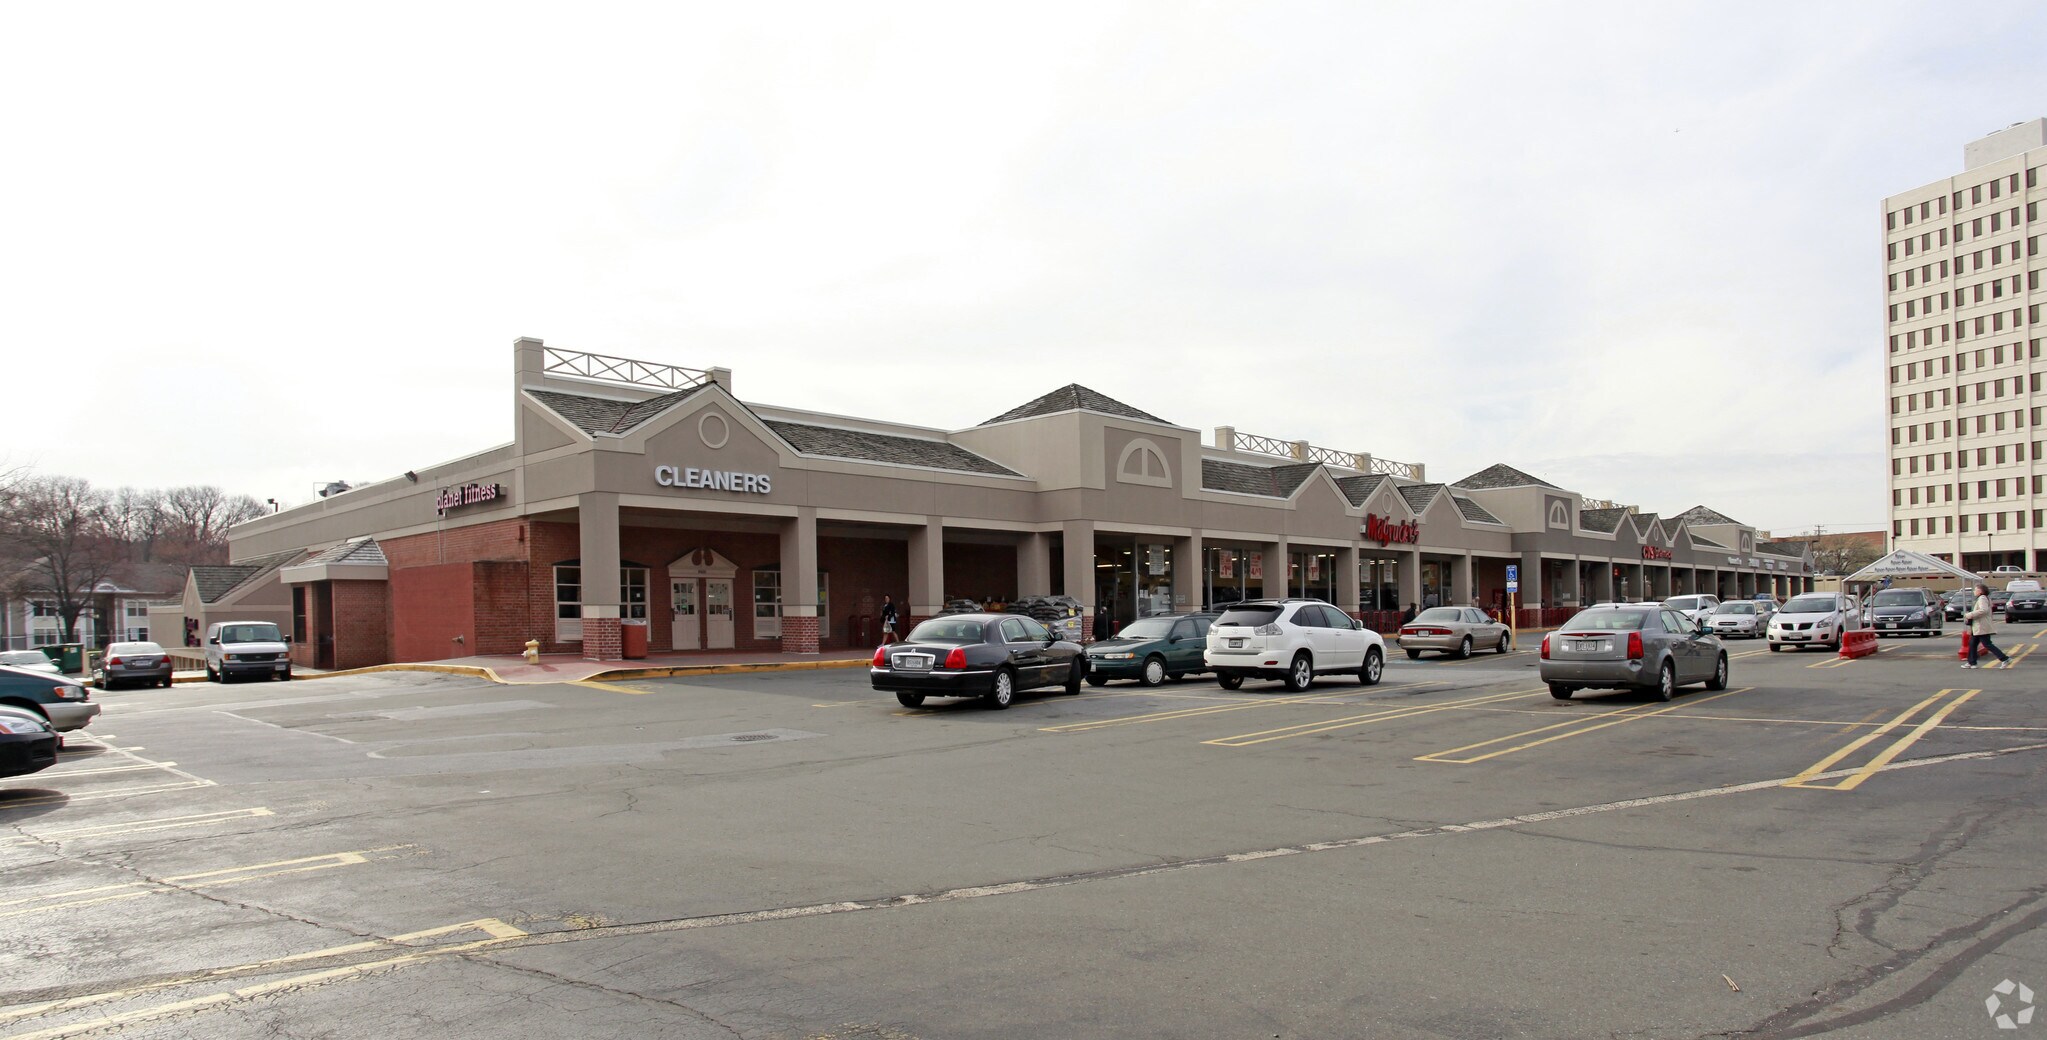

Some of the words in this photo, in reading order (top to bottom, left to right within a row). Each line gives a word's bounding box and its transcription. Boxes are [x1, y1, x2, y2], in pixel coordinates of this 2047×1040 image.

[655, 465, 771, 494] CLEANERS
[436, 490, 462, 516] planet
[464, 483, 497, 504] fitness
